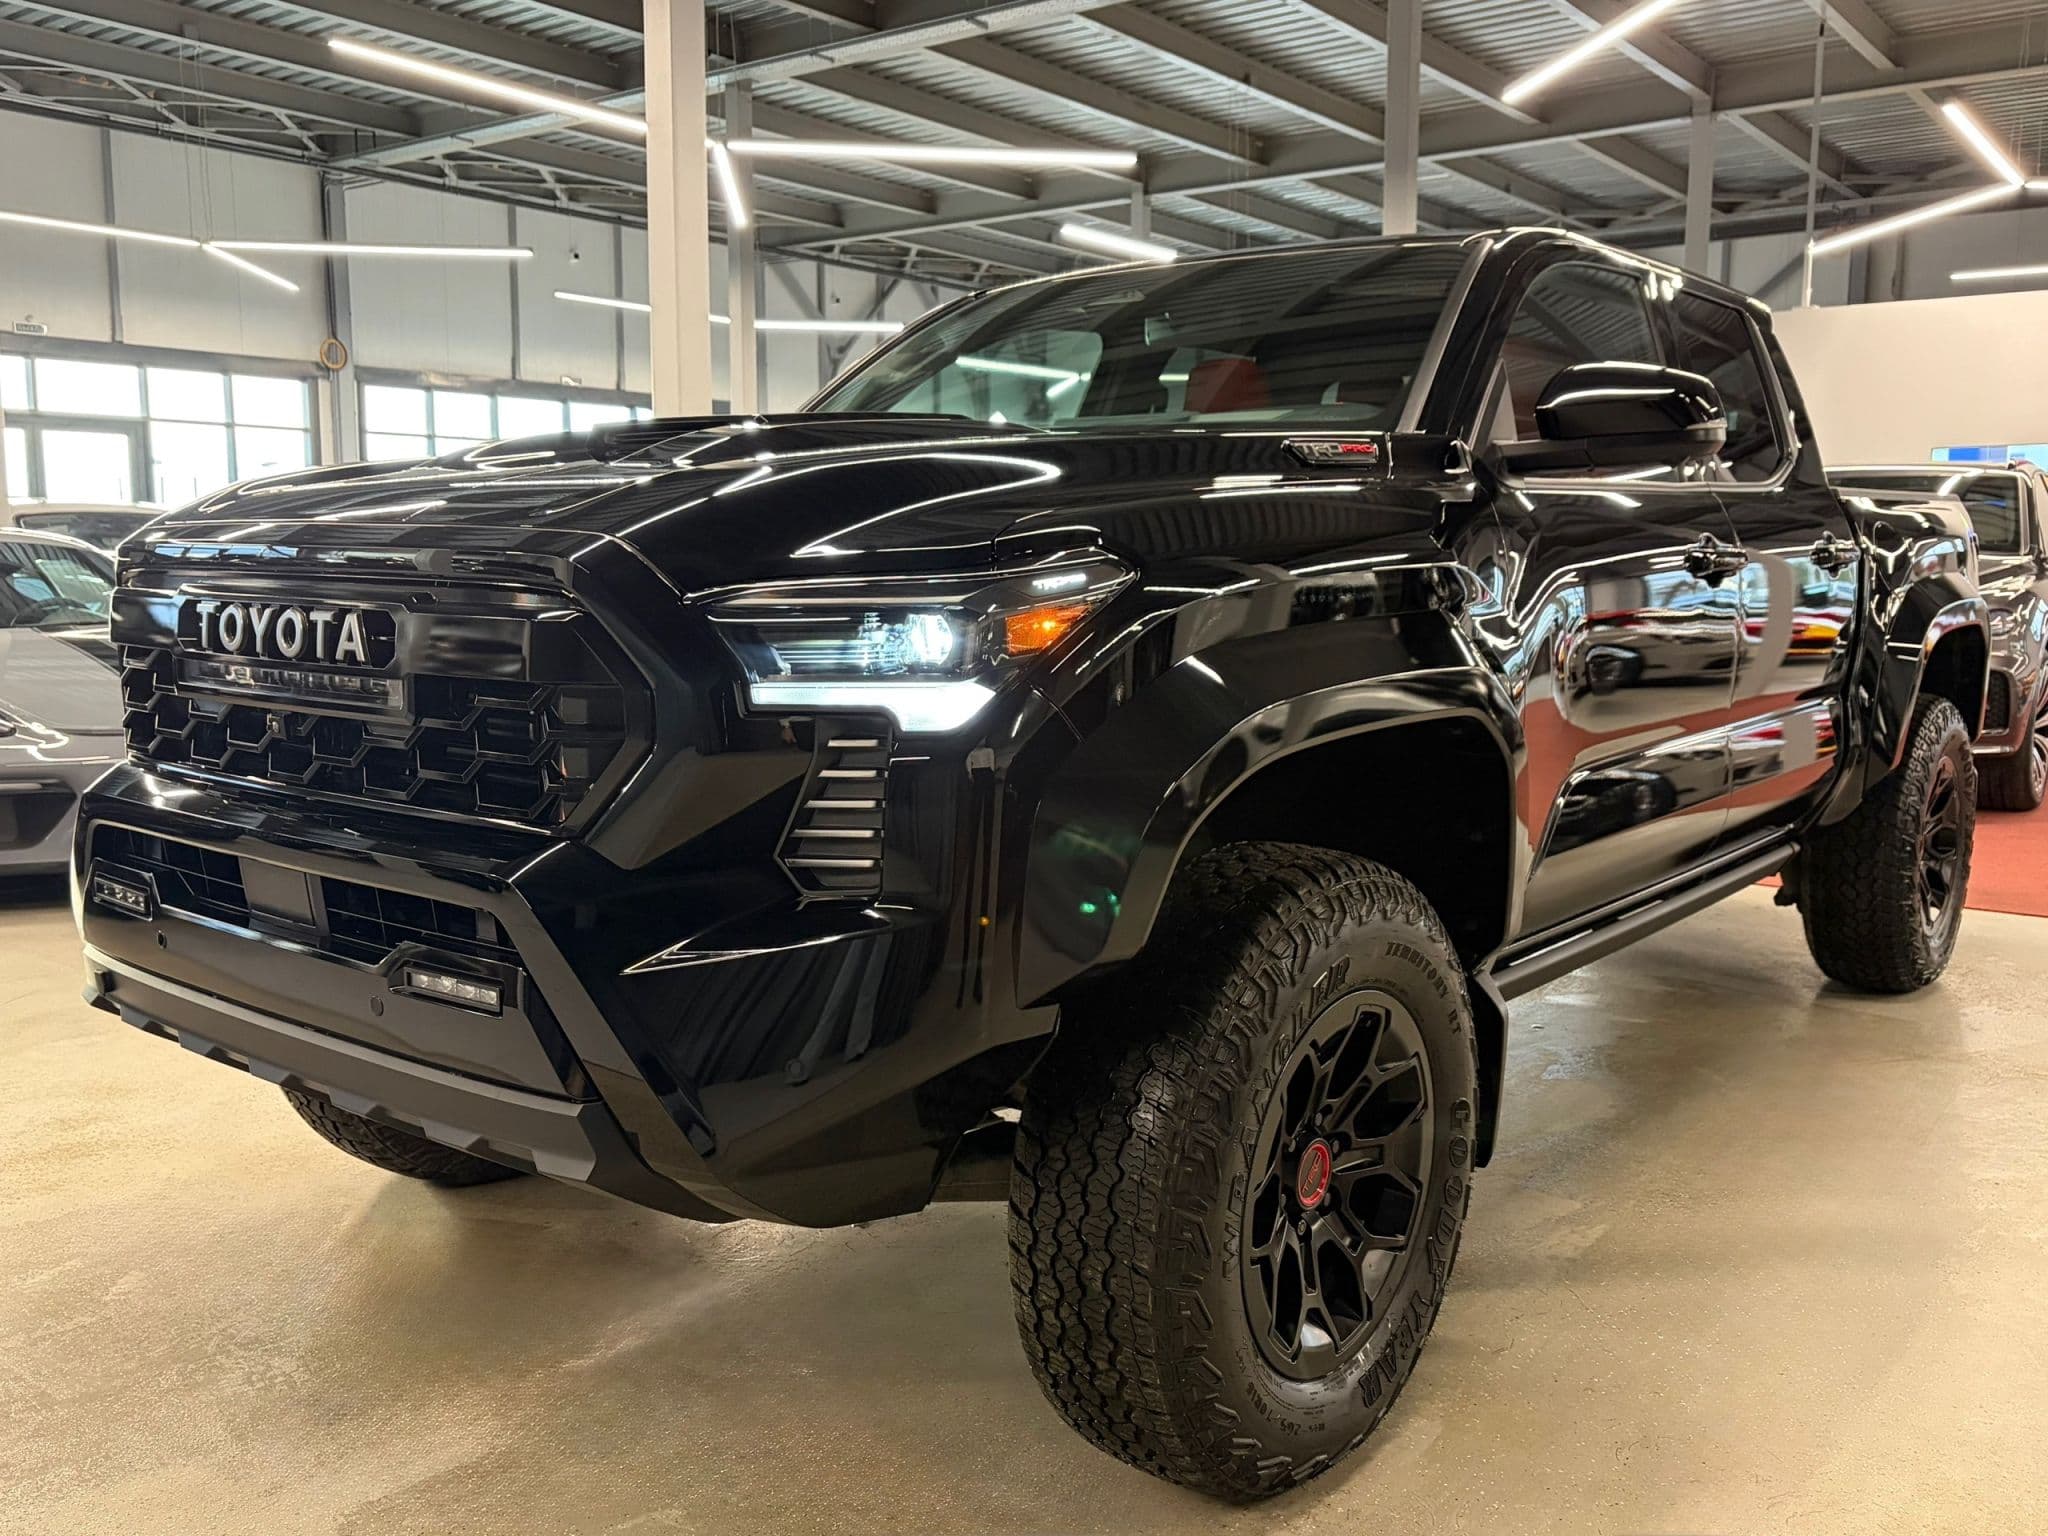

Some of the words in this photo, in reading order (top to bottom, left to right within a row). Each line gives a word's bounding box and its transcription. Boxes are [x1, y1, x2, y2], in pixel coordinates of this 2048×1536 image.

[1294, 442, 1342, 457] TRD
[1341, 444, 1375, 453] PRO
[196, 600, 370, 664] TOYOTA
[1385, 942, 1449, 999] TERRITORY
[1222, 954, 1350, 1280] WRANGLER
[1357, 1097, 1471, 1408] GOODYEAR
